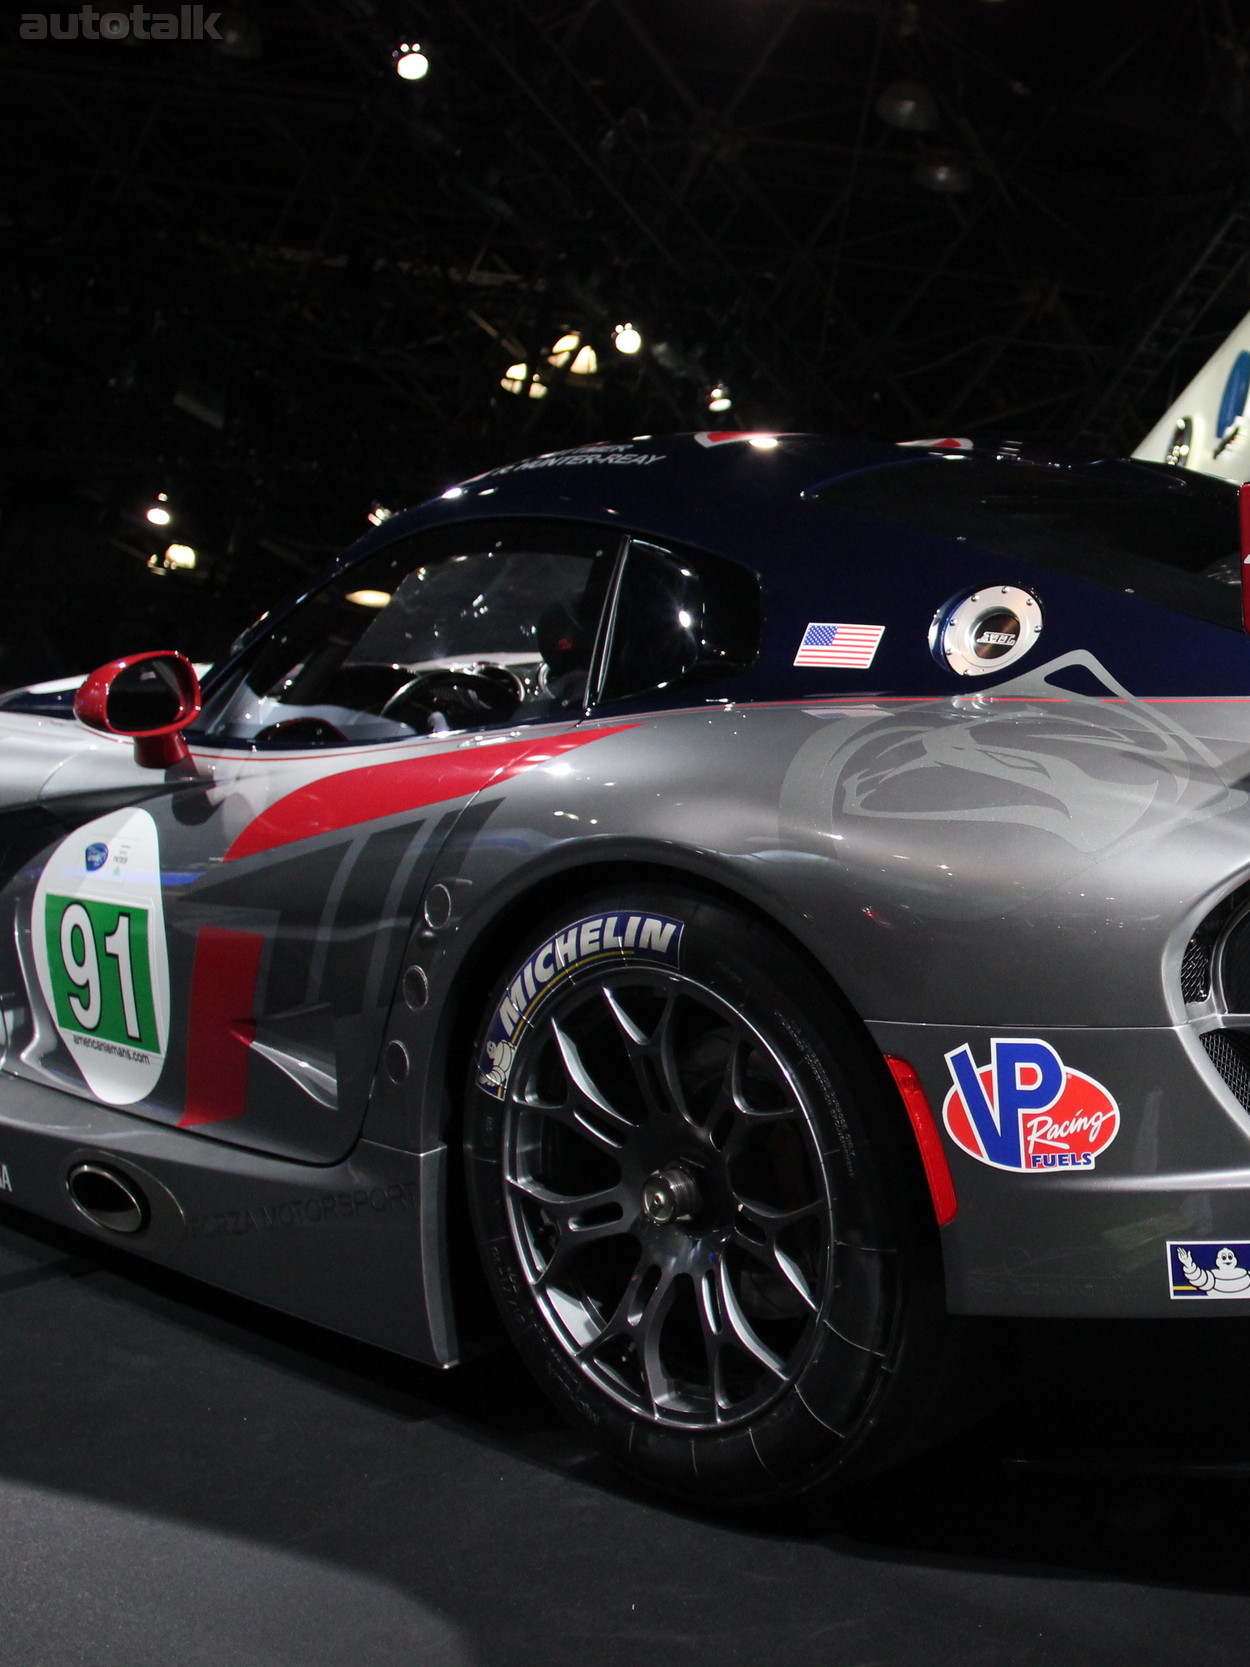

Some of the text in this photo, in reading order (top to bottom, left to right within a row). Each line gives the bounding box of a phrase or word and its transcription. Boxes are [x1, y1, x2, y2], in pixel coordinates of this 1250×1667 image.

[60, 901, 143, 1041] 91
[500, 916, 676, 1037] MICHELIN
[73, 1034, 151, 1065] americanlemans.com
[946, 1039, 1065, 1169] VP
[1027, 1109, 1116, 1154] Racing
[1030, 1152, 1093, 1168] FUELS
[260, 1181, 416, 1227] MOTORSPORT
